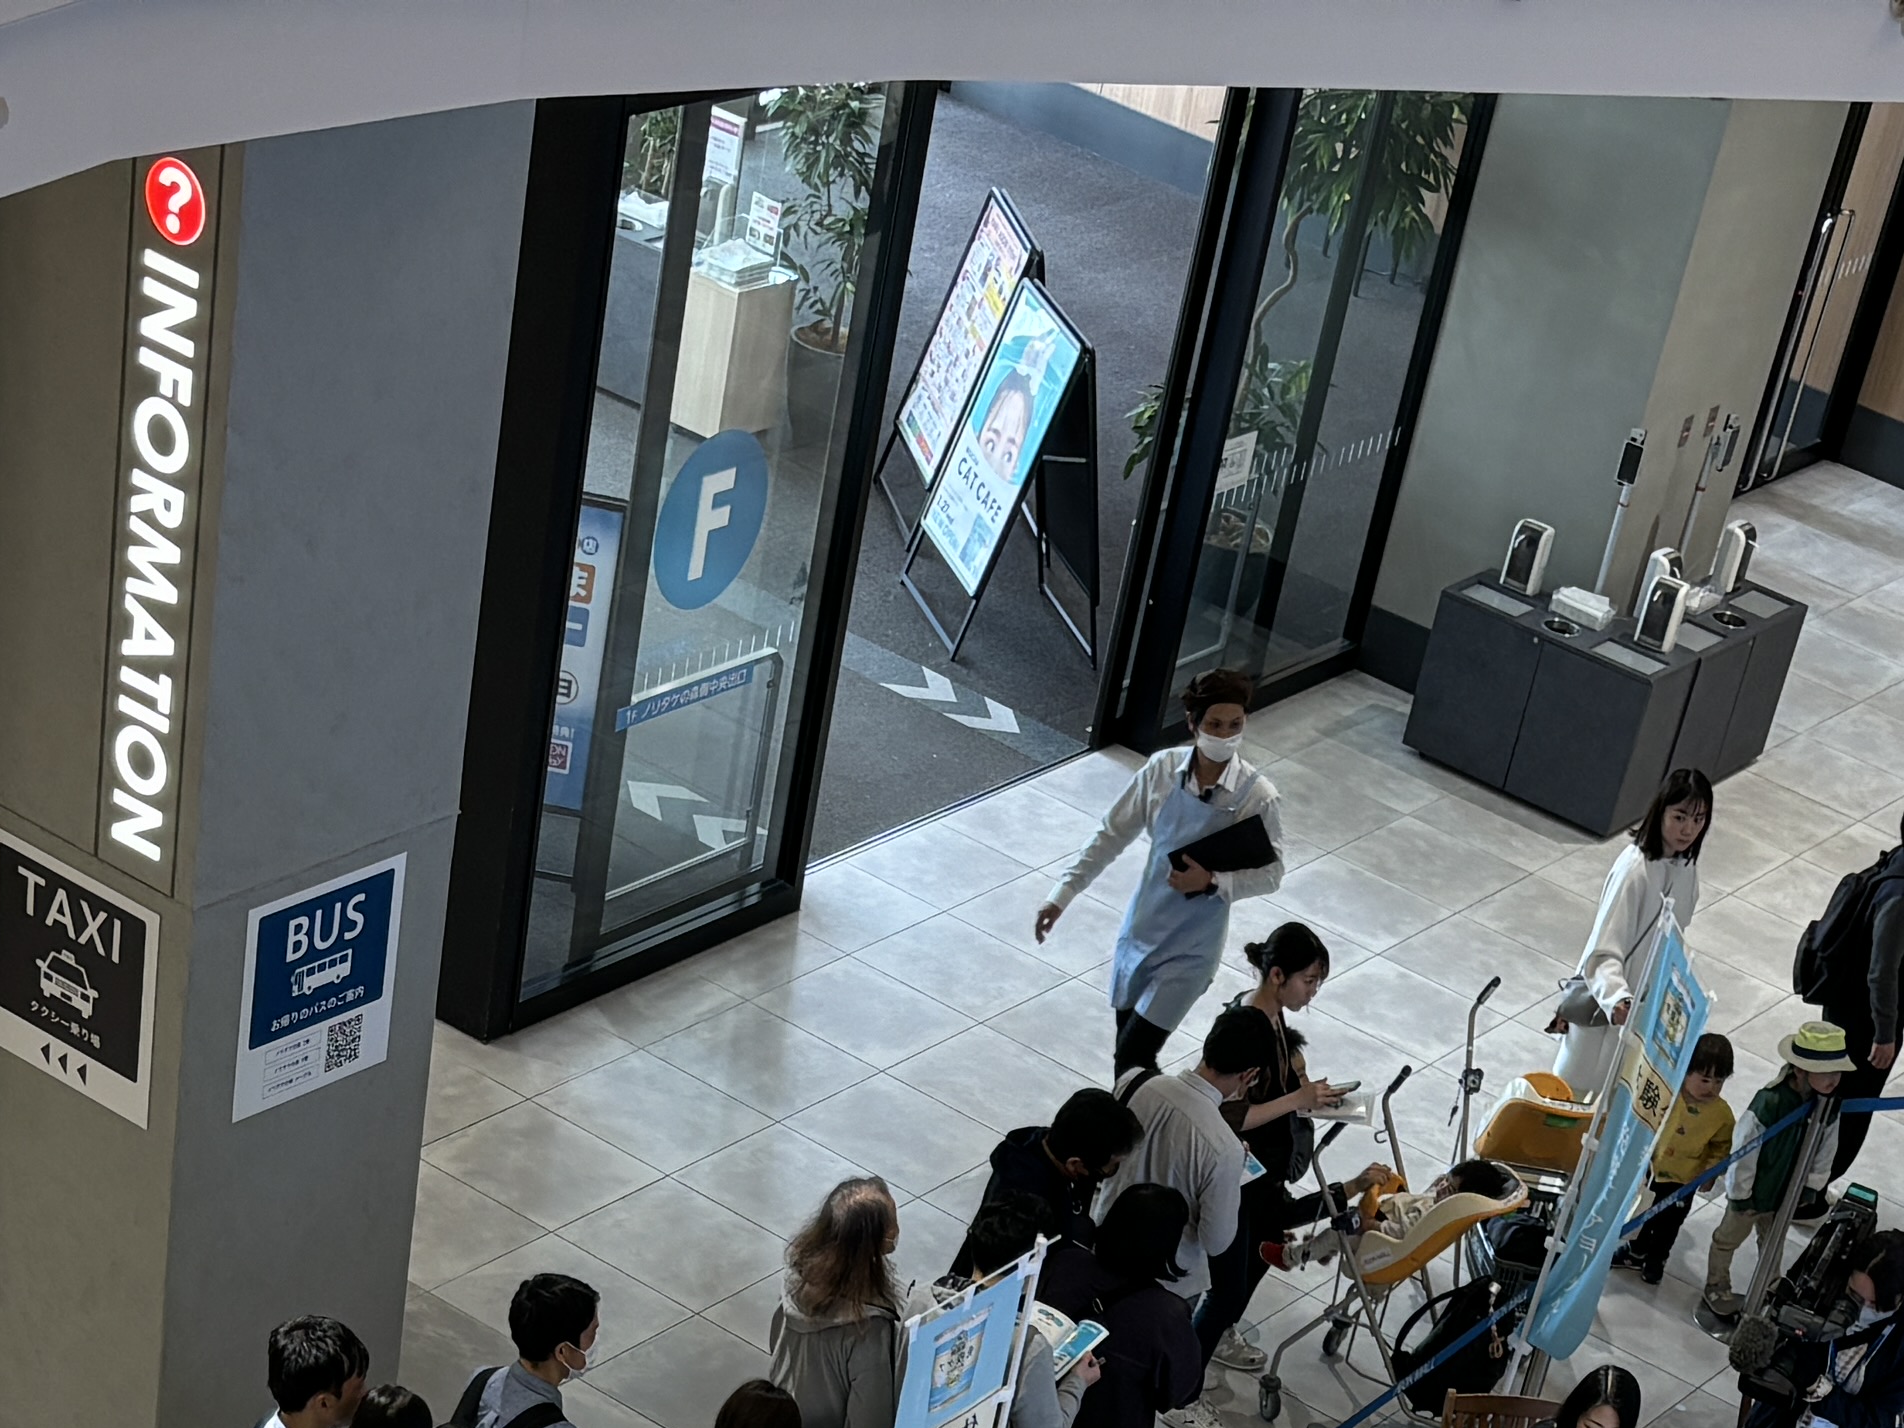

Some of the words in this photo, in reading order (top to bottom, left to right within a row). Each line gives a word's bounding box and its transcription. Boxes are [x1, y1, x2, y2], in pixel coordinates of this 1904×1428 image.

[957, 457, 979, 493] CAT
[110, 247, 201, 862] INFORMATION
[687, 467, 737, 581] F
[18, 865, 121, 964] TAXI
[286, 893, 366, 963] BUS
[30, 1001, 101, 1049] タクシー乗り場
[271, 986, 365, 1032] お帰りのバスのご案内
